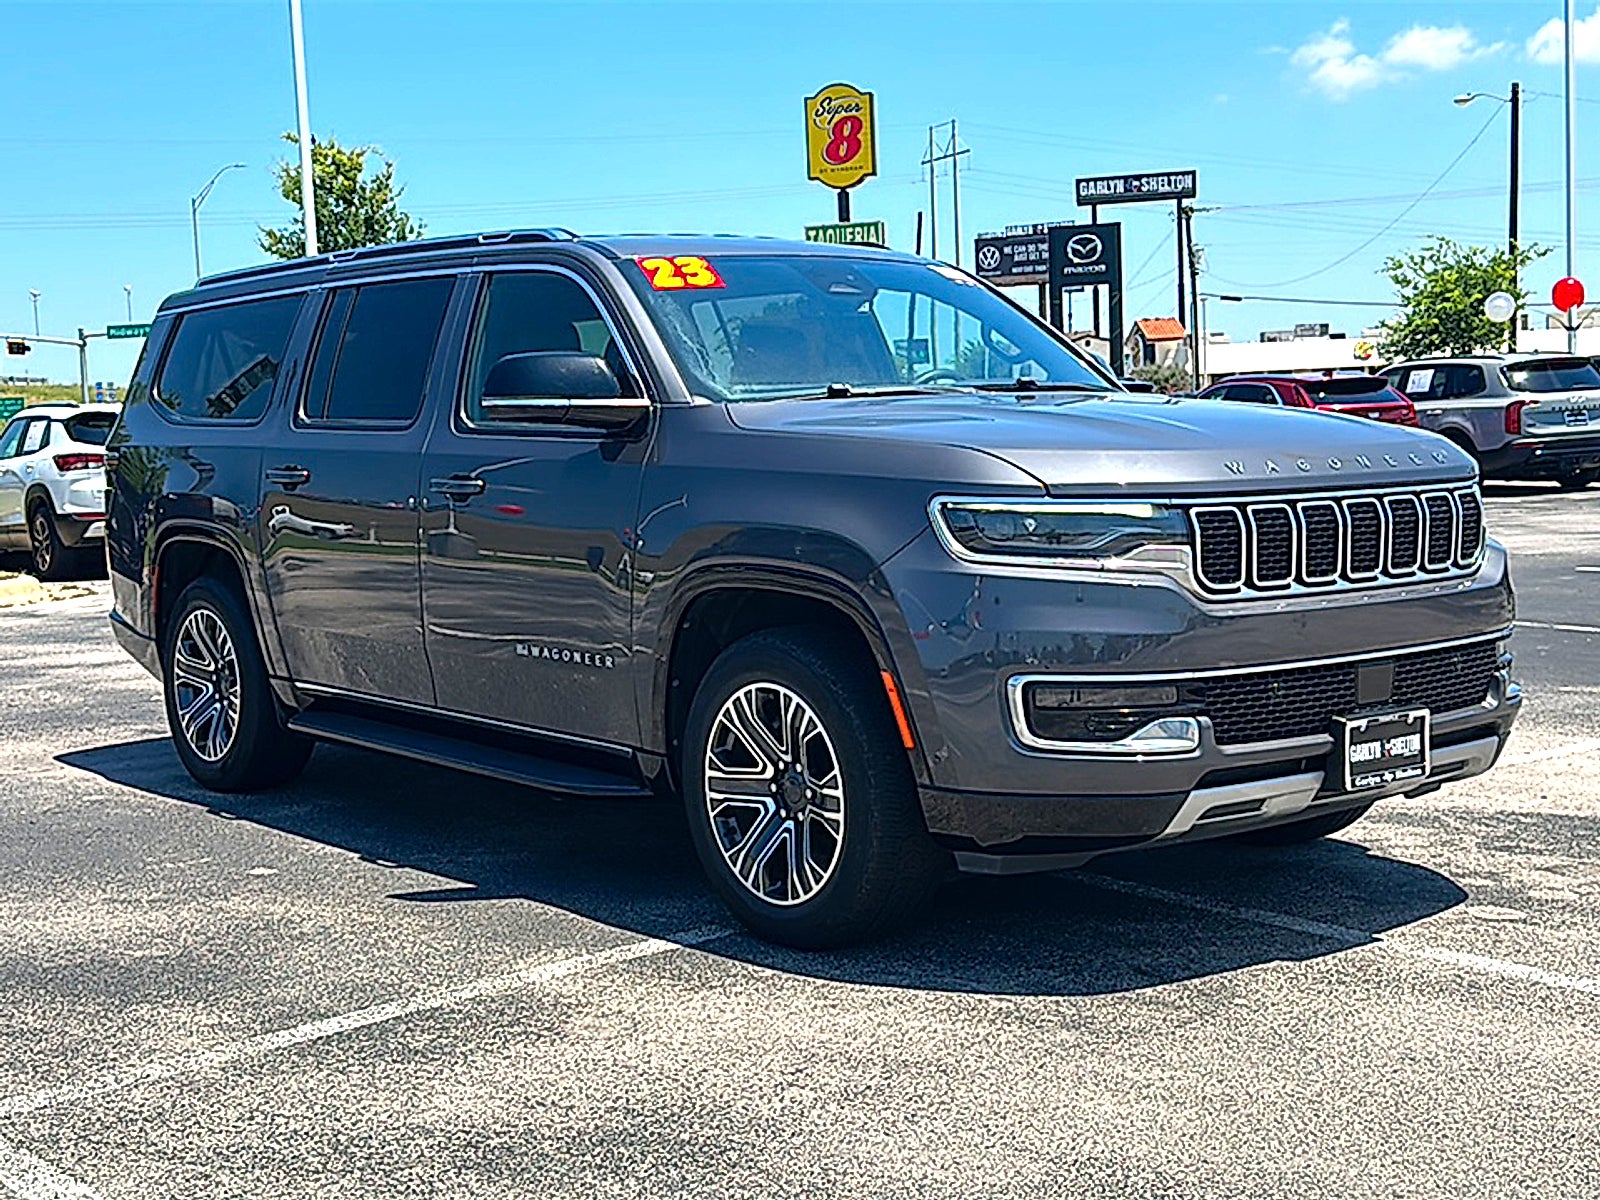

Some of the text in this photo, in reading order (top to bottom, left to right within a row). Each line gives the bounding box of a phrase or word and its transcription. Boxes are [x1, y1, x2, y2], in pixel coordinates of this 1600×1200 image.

[814, 96, 863, 126] Super
[824, 115, 863, 165] 8
[1079, 174, 1193, 197] GARLYN SHELTON
[642, 257, 716, 288] 23
[1064, 264, 1106, 274] mazda
[1224, 448, 1448, 476] WAGONEER
[530, 644, 614, 668] WAGONEER
